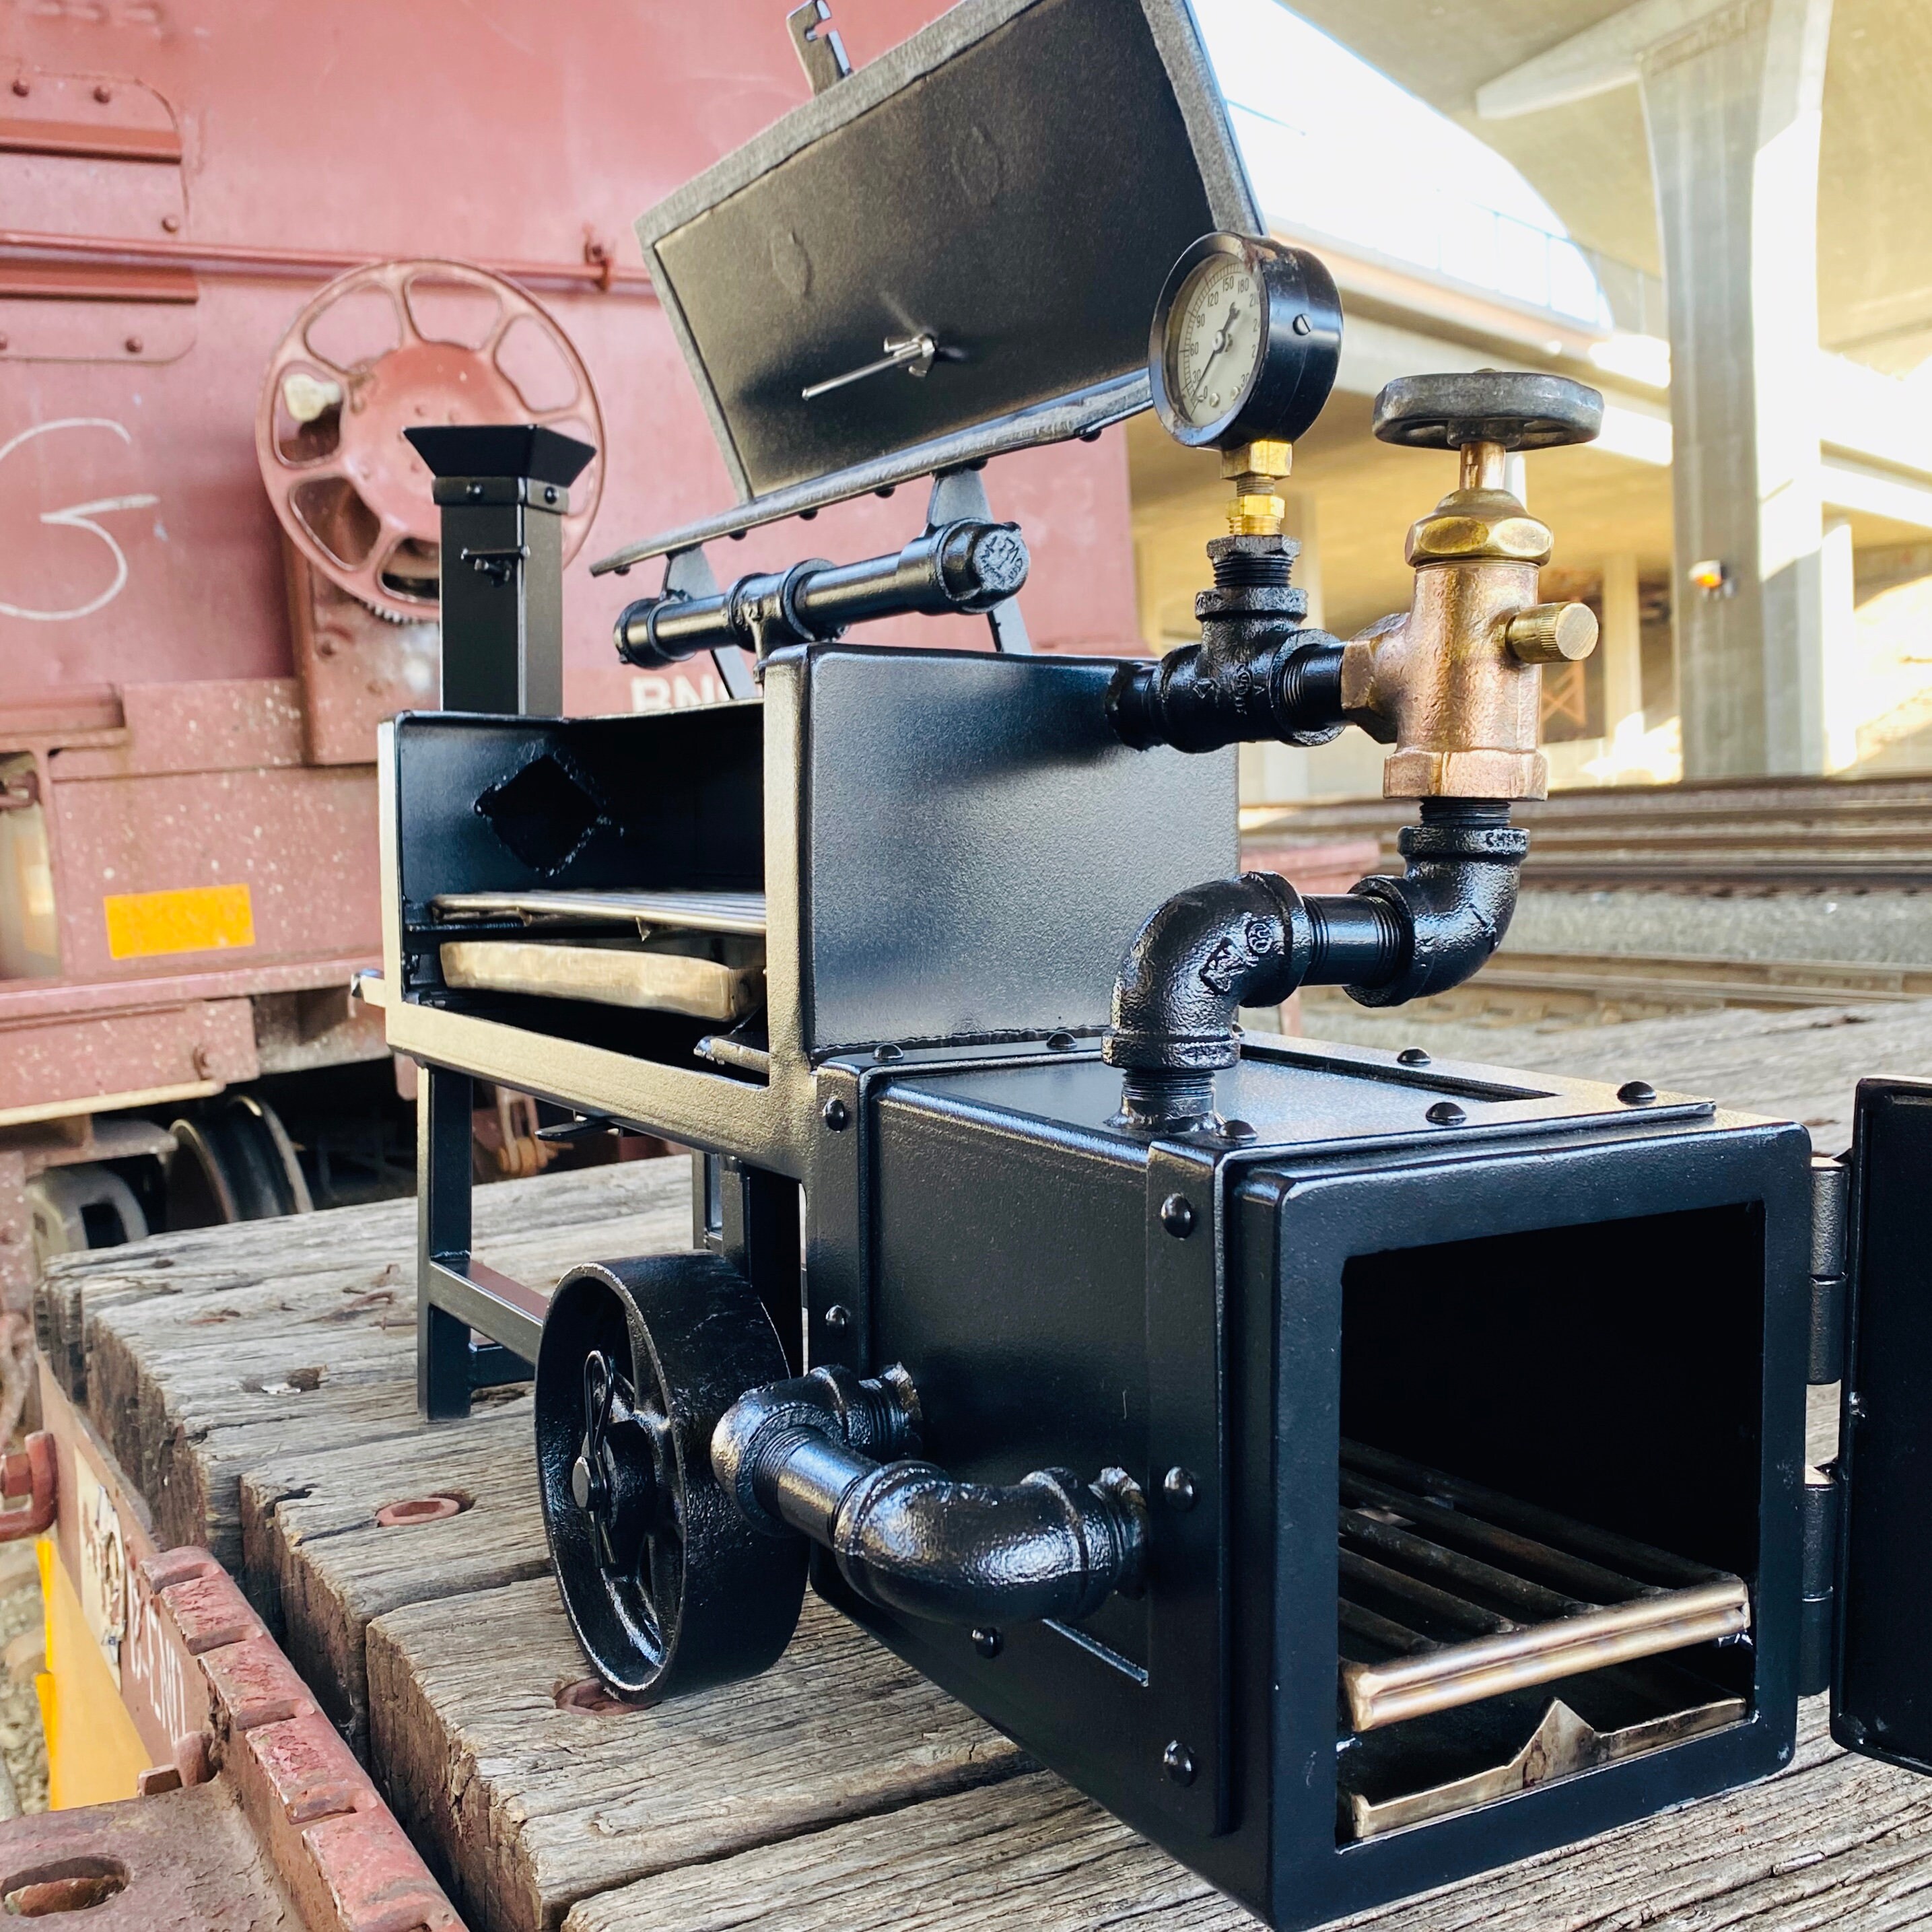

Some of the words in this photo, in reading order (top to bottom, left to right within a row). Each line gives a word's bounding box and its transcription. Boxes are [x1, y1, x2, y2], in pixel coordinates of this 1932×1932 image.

[1222, 275, 1234, 293] 150
[1238, 277, 1249, 295] 180
[1208, 291, 1219, 308] 120
[1196, 313, 1205, 329] 90
[1190, 341, 1199, 357] 60
[1193, 369, 1201, 384] 30
